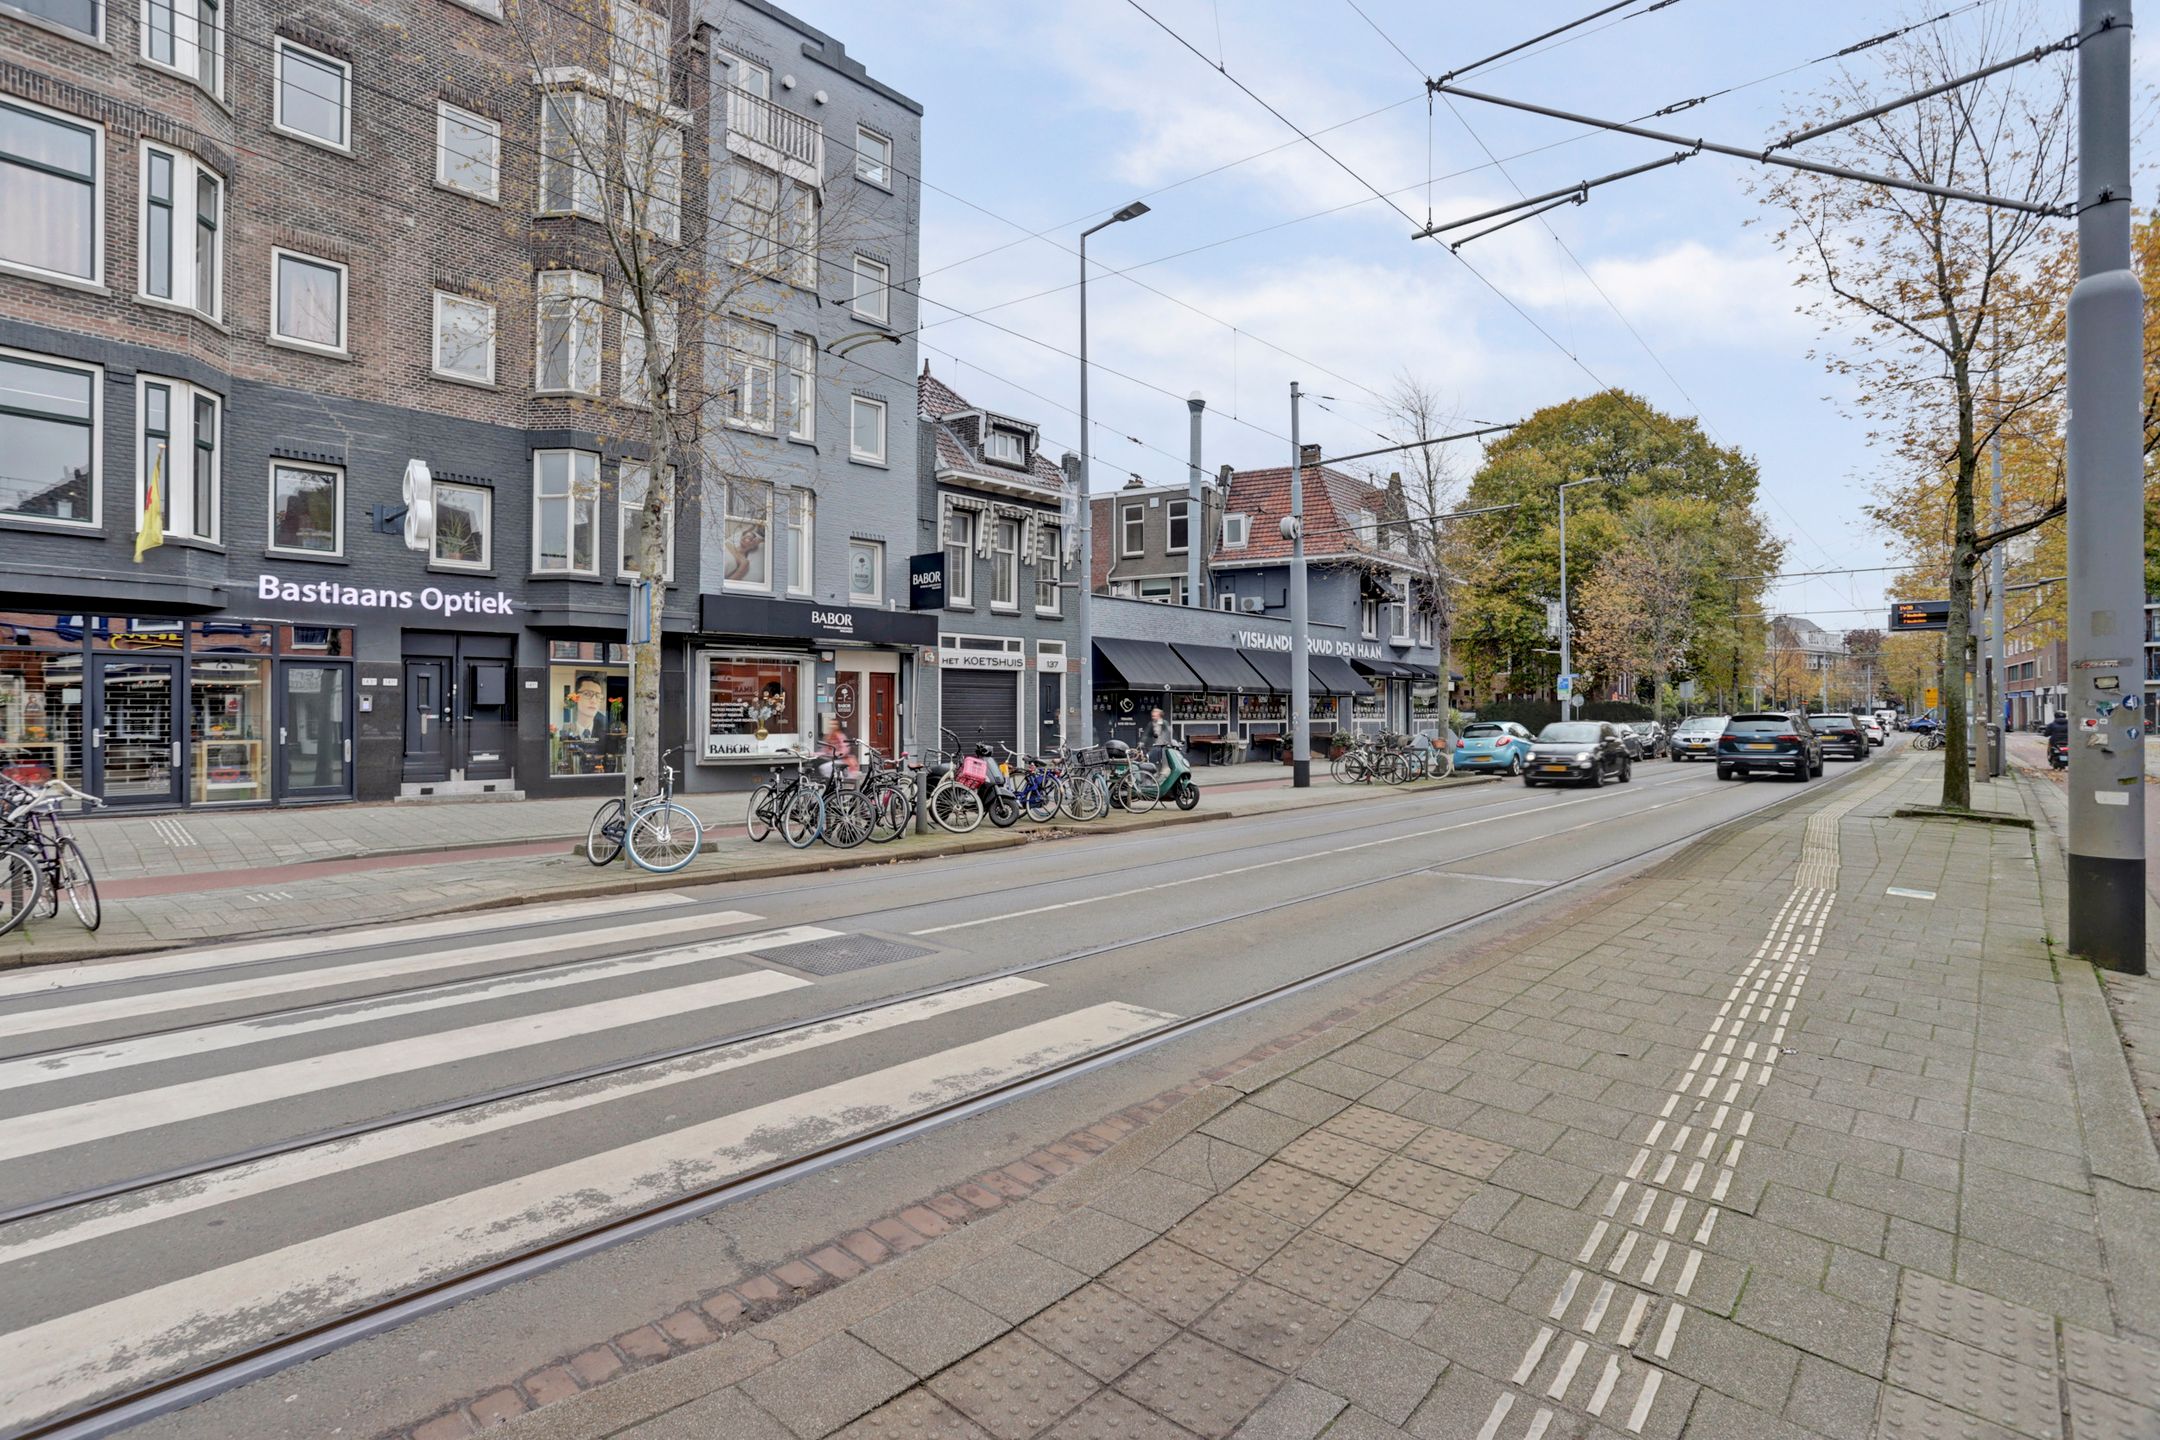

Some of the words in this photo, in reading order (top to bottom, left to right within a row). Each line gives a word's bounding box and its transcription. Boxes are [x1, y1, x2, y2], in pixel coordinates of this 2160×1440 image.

[912, 571, 941, 586] BABOR
[420, 587, 514, 617] Optiek
[811, 611, 853, 626] BABOR
[1307, 638, 1333, 655] RUUD
[1336, 640, 1356, 657] DEN
[1357, 644, 1382, 659] HAAN
[942, 657, 960, 665] HET
[963, 656, 1024, 667] KOETSHUIS
[710, 743, 751, 755] BABOR
